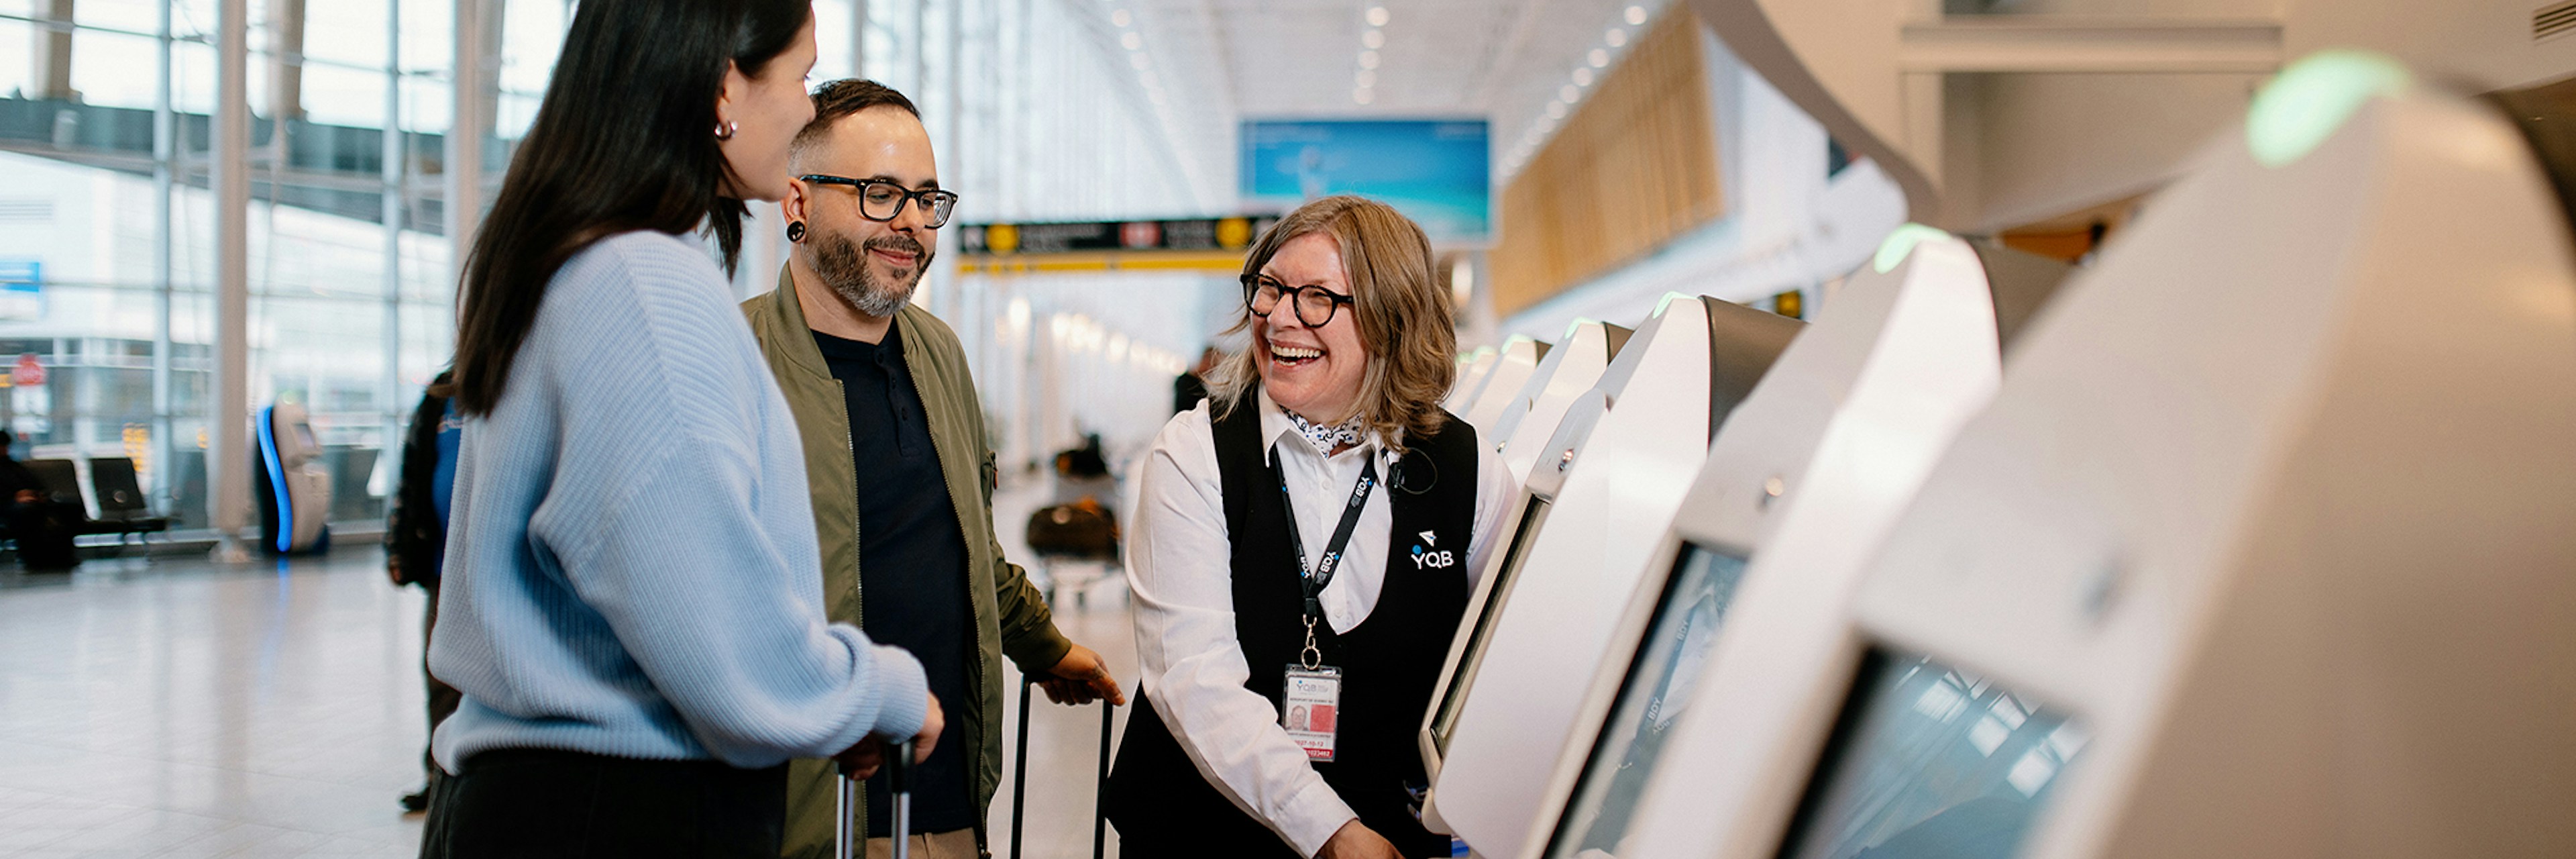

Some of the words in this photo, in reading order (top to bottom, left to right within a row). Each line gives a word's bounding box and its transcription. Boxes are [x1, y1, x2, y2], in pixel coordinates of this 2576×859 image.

[1356, 476, 1370, 497] YQB
[1320, 552, 1336, 572] YQB
[1411, 550, 1454, 570] YQB
[1296, 684, 1317, 692] YQB
